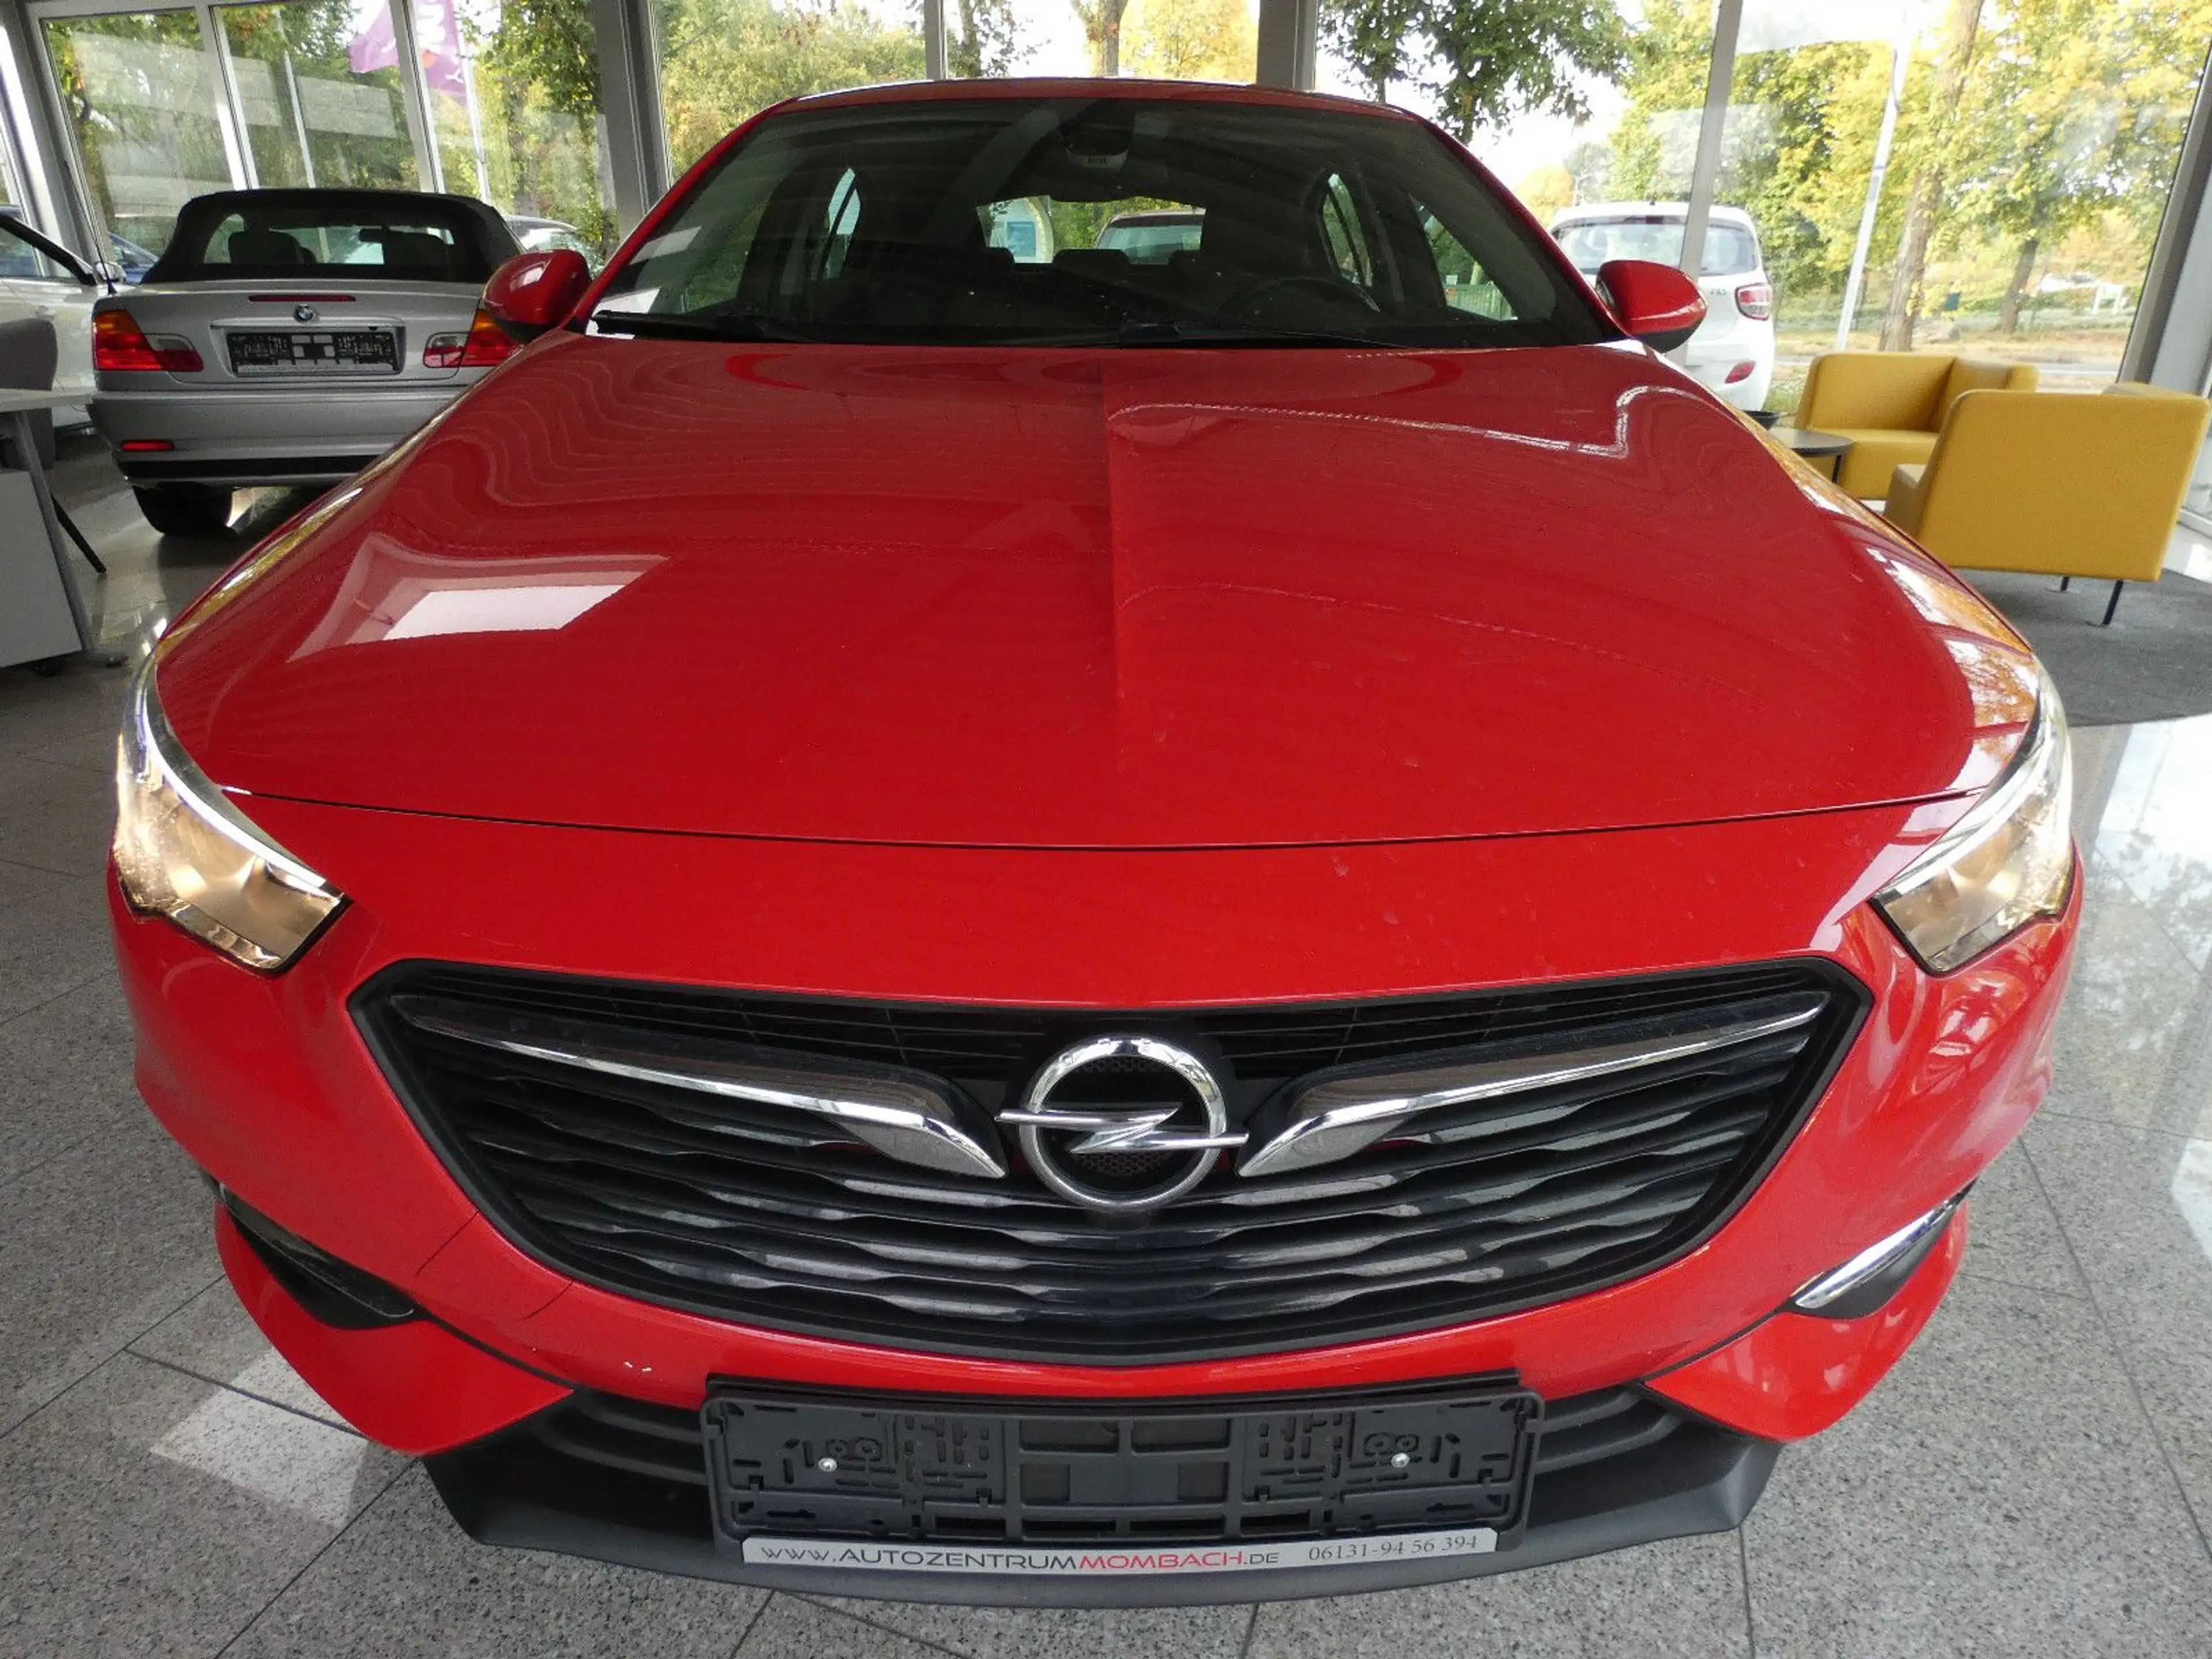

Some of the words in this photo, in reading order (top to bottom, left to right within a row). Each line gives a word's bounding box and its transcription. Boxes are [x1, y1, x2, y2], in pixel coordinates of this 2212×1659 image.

[1309, 1540, 1404, 1560] 06131-94
[1411, 1538, 1435, 1553] 56
[1441, 1535, 1479, 1551] 394
